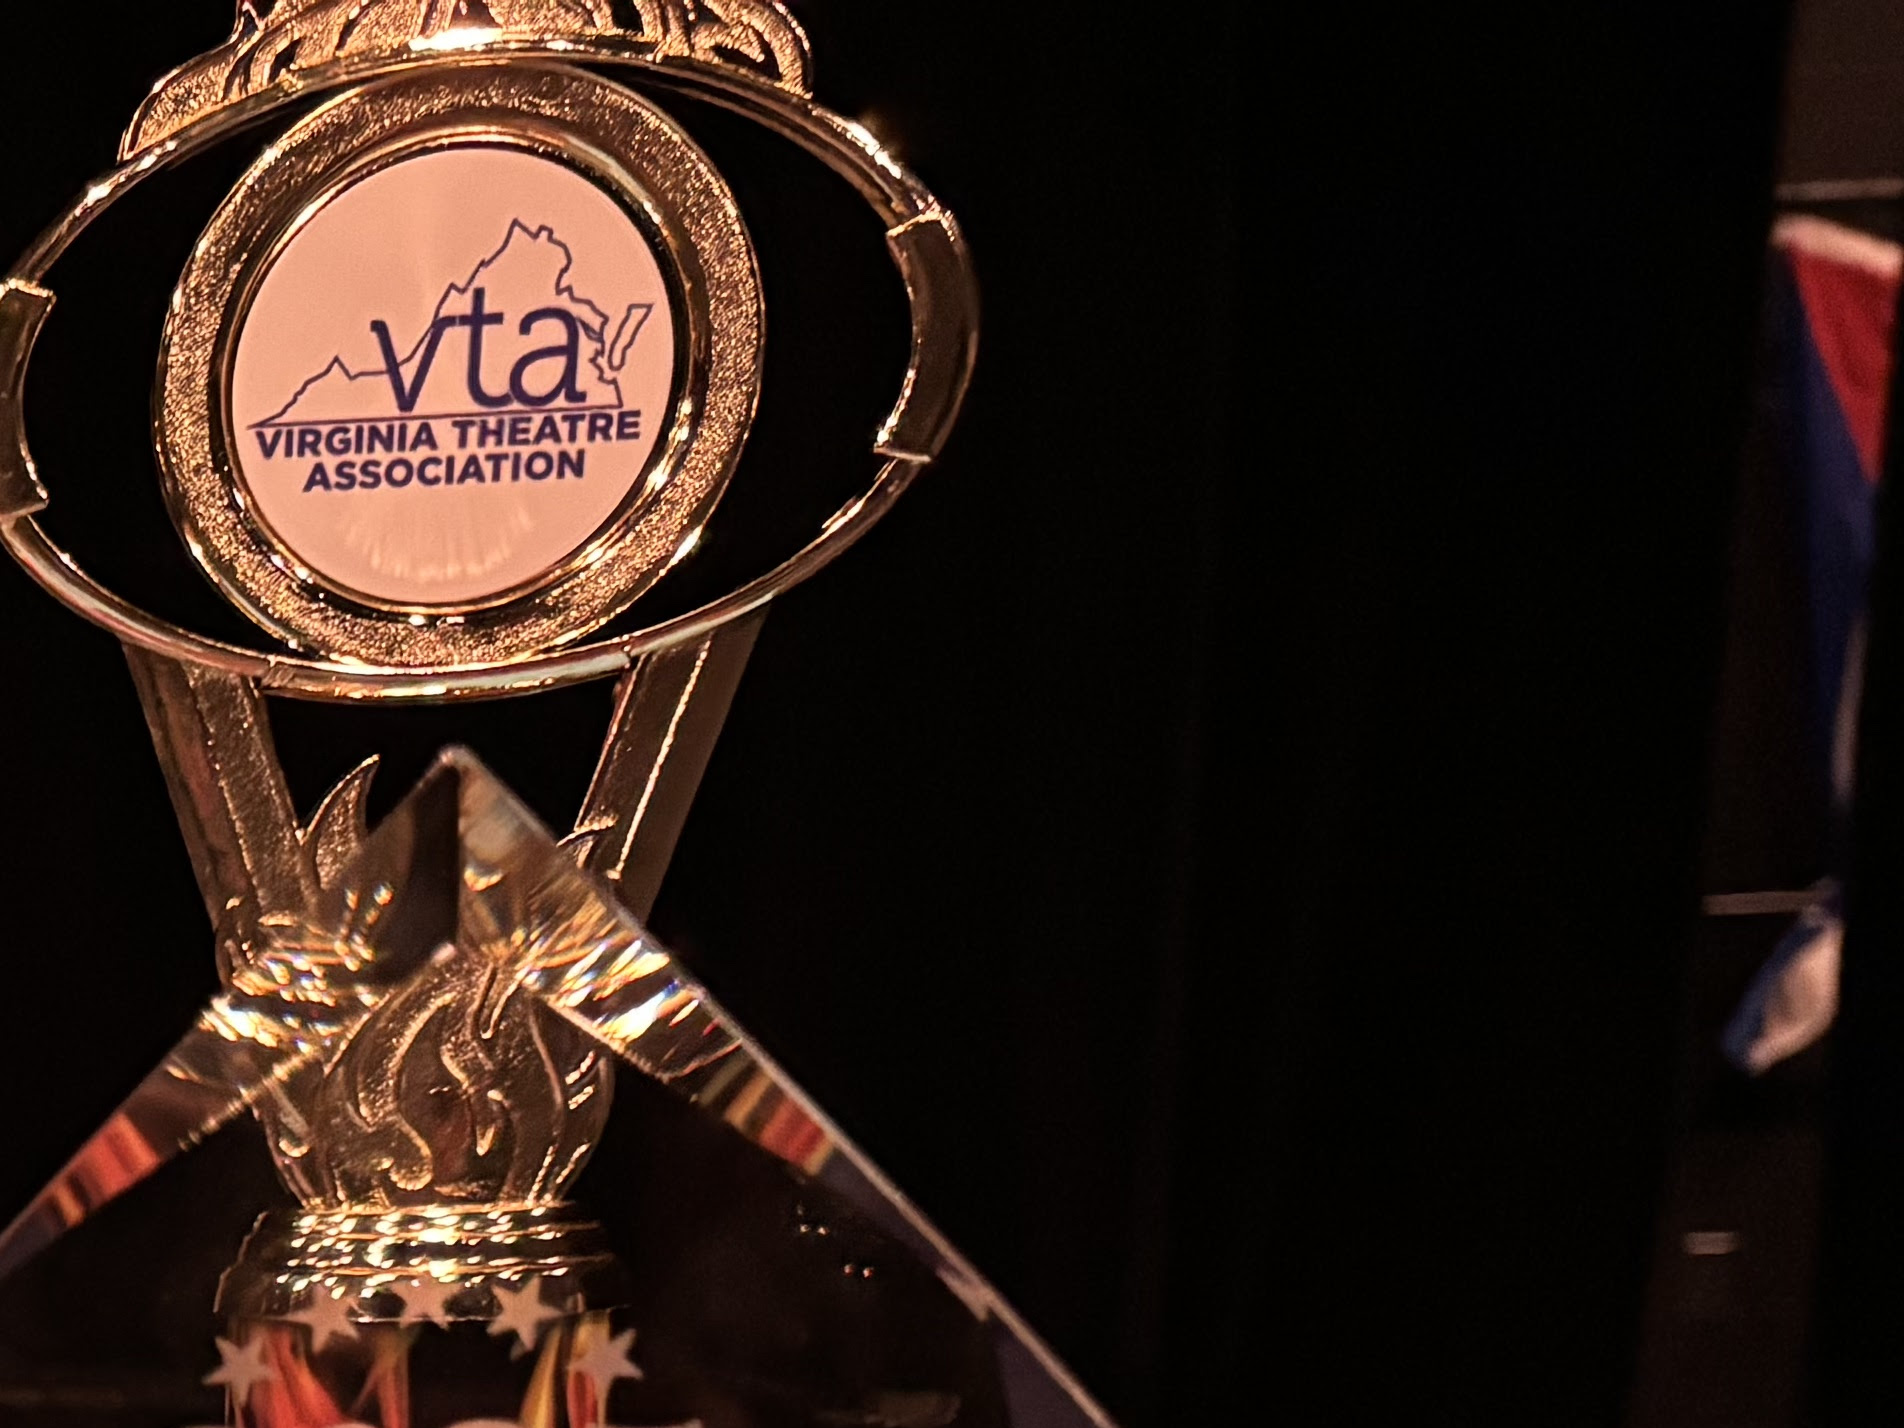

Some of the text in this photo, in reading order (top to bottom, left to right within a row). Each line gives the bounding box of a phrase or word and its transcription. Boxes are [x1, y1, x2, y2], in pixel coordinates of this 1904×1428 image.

[370, 287, 588, 414] vta
[256, 409, 642, 459] VIRGINIA THEATRE
[302, 448, 587, 493] ASSOCIATION
